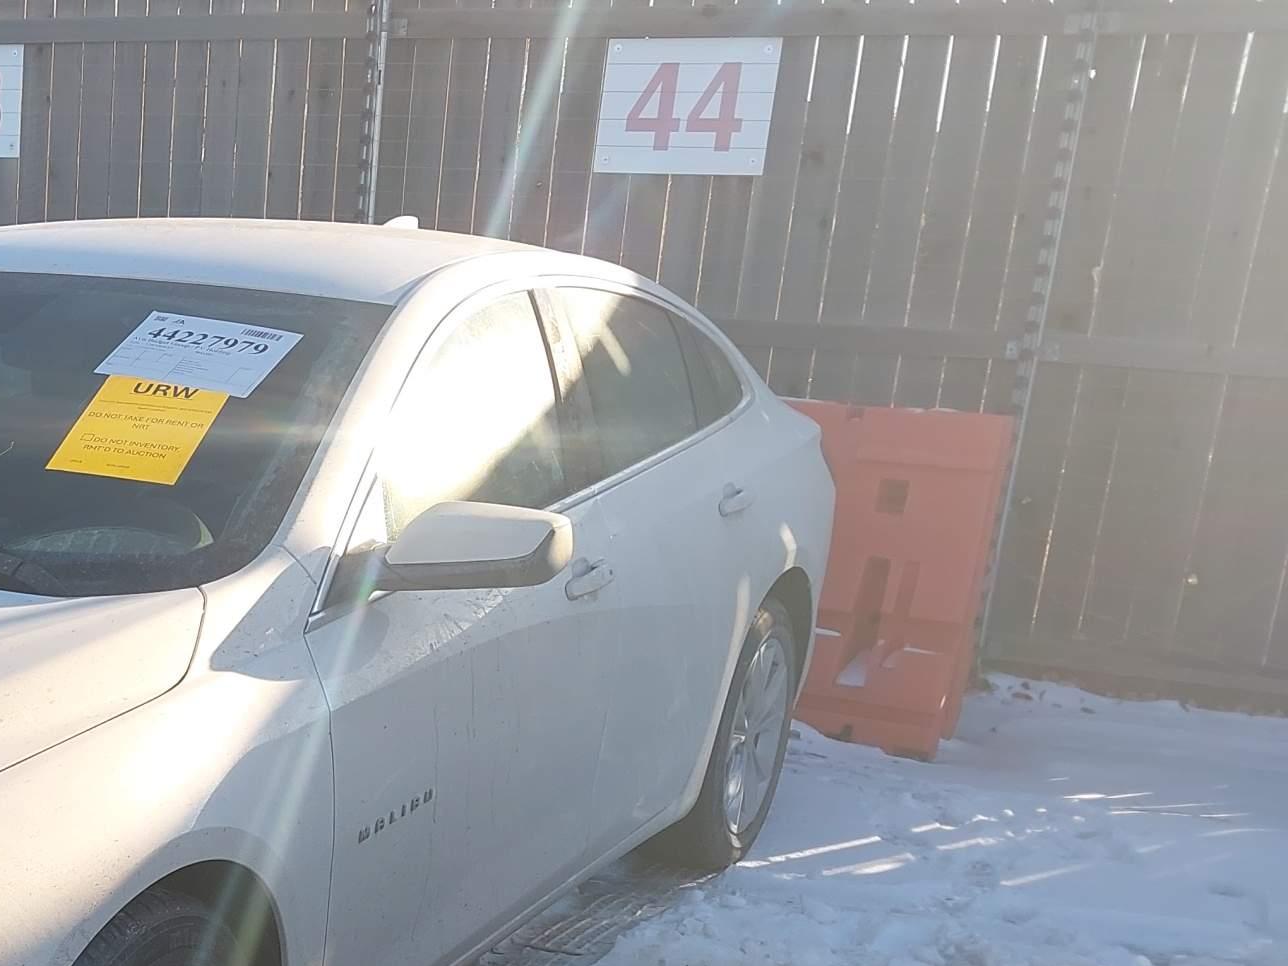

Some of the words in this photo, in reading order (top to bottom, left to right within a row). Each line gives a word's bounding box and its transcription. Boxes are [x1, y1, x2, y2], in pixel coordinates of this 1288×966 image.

[624, 62, 743, 152] 44
[148, 327, 269, 355] 44227979
[133, 382, 199, 399] URW
[123, 414, 144, 422] TAKE
[145, 416, 164, 424] FOR
[165, 418, 189, 427] RENT
[124, 448, 167, 459] AUCTION
